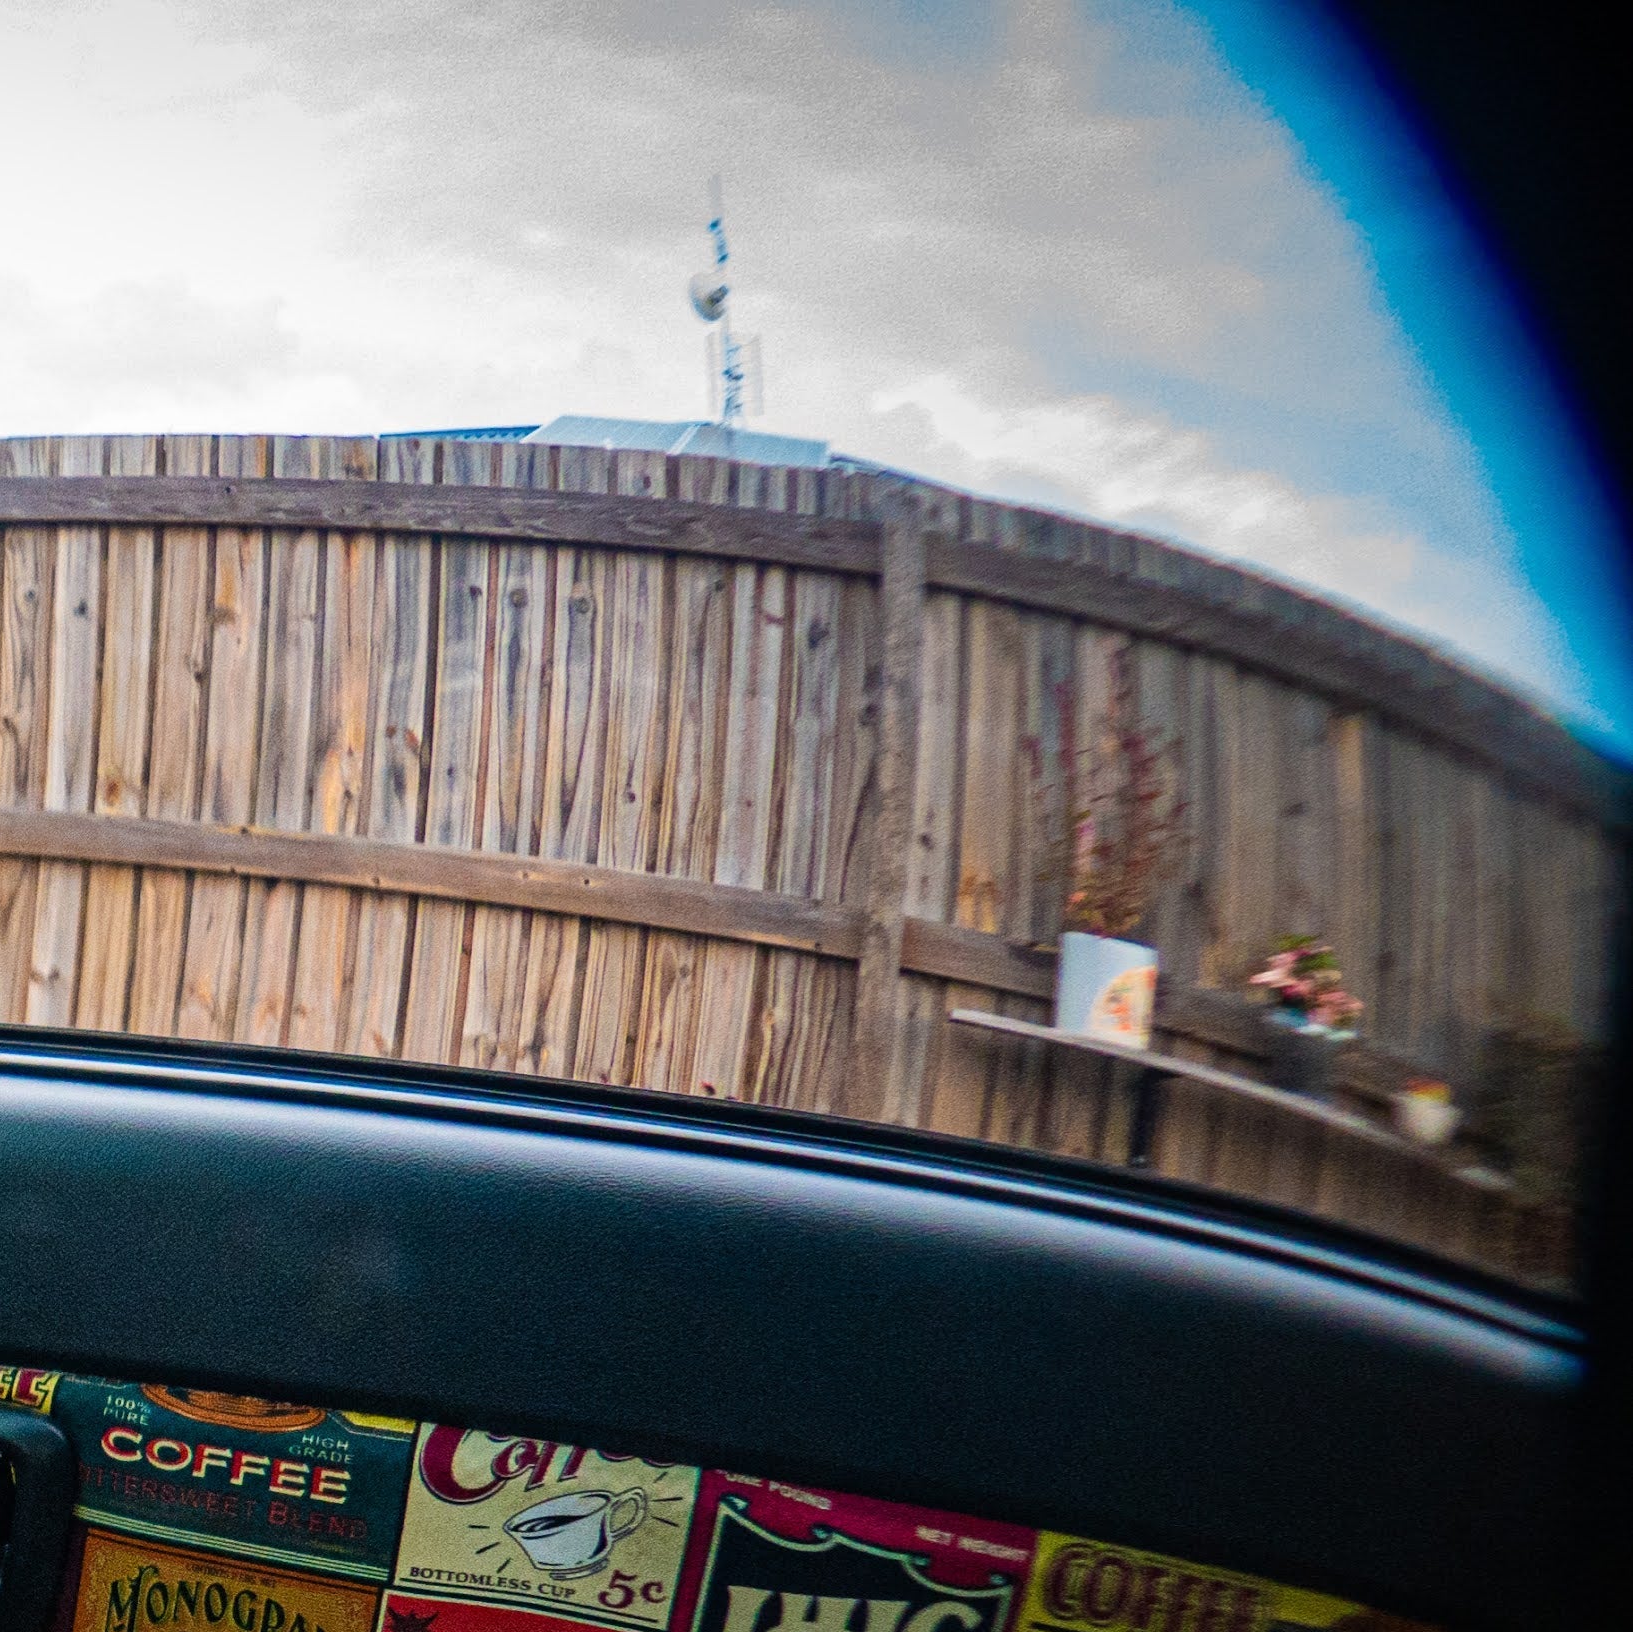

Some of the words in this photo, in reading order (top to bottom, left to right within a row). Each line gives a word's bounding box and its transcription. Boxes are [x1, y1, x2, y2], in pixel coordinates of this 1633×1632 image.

[103, 1407, 148, 1426] PURE
[288, 1444, 354, 1465] GRADE
[301, 1433, 349, 1450] HIGH
[101, 1425, 352, 1504] COFFEE
[78, 1462, 257, 1519] ITTERSWEET
[266, 1499, 368, 1539] BLEND
[409, 1566, 532, 1591] BOTTOMLESS
[537, 1583, 577, 1600] CUP
